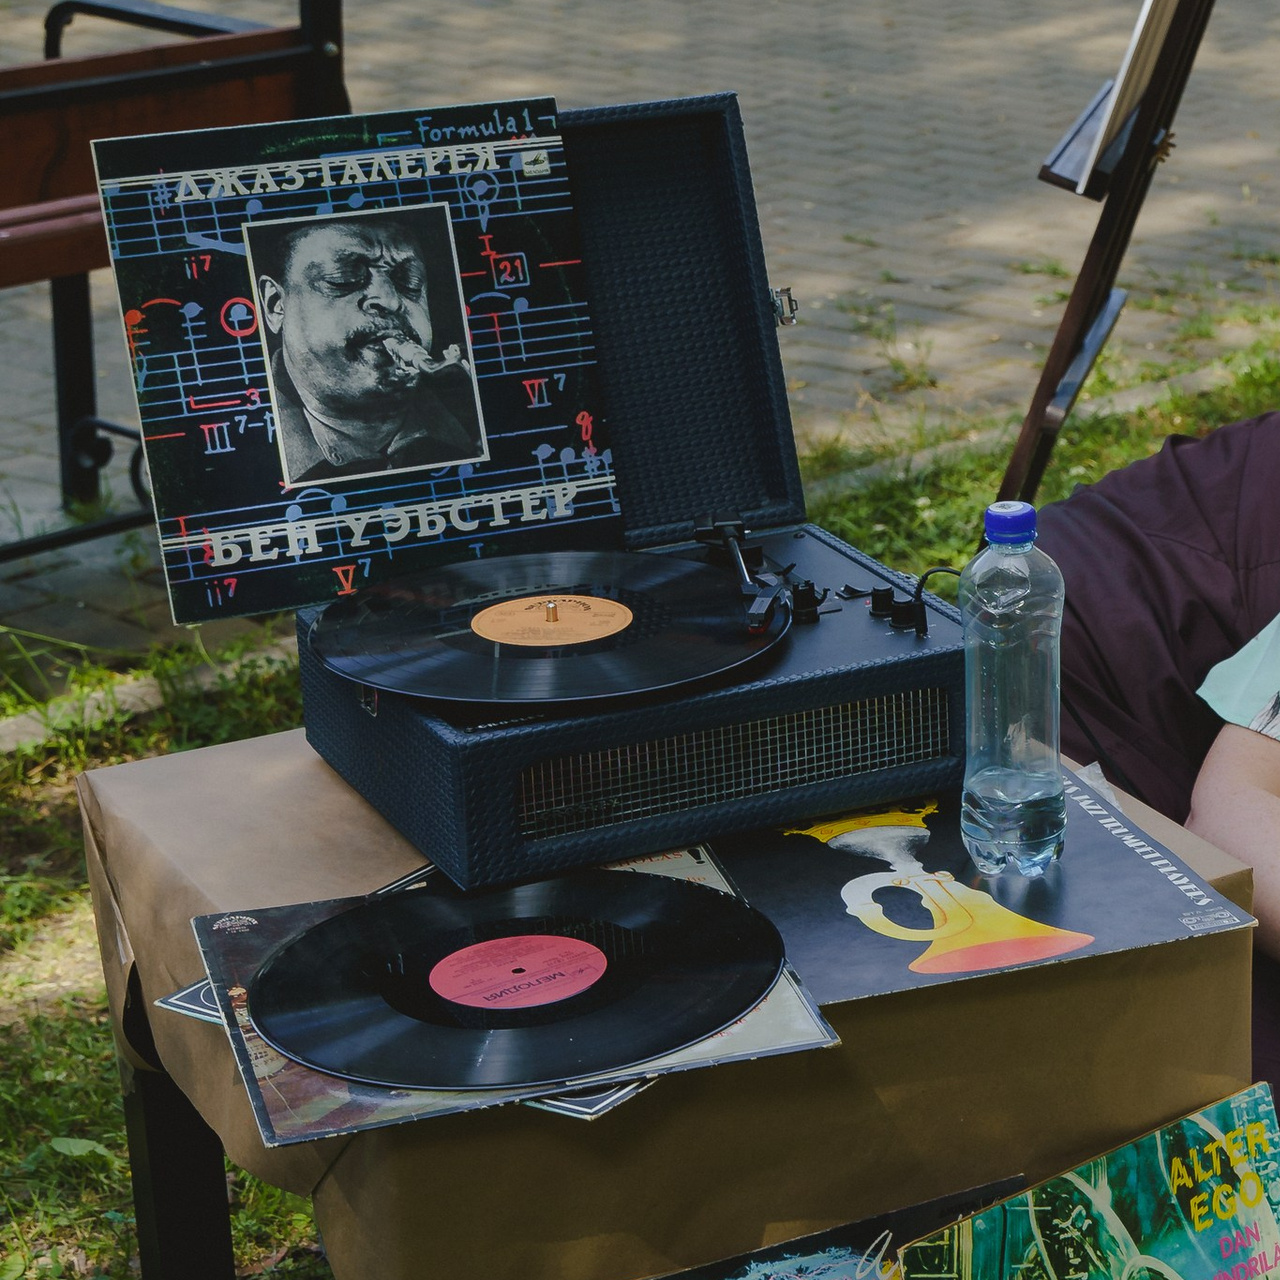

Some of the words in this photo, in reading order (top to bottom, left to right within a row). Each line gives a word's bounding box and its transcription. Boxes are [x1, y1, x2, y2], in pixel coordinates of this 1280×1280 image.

[415, 109, 518, 143] Formula
[174, 145, 501, 203] ДЖАЗ-ГАЛЕРЕЯ
[209, 520, 323, 568] БЕН
[342, 484, 580, 547] УЭБСТЕР
[1069, 794, 1109, 818] JAZZ
[1098, 816, 1165, 861] TRUMPET
[1150, 859, 1215, 907] PLAYERS
[1170, 1121, 1270, 1196] ALTER
[1189, 1171, 1264, 1233] EGO
[1219, 1220, 1261, 1260] DAN
